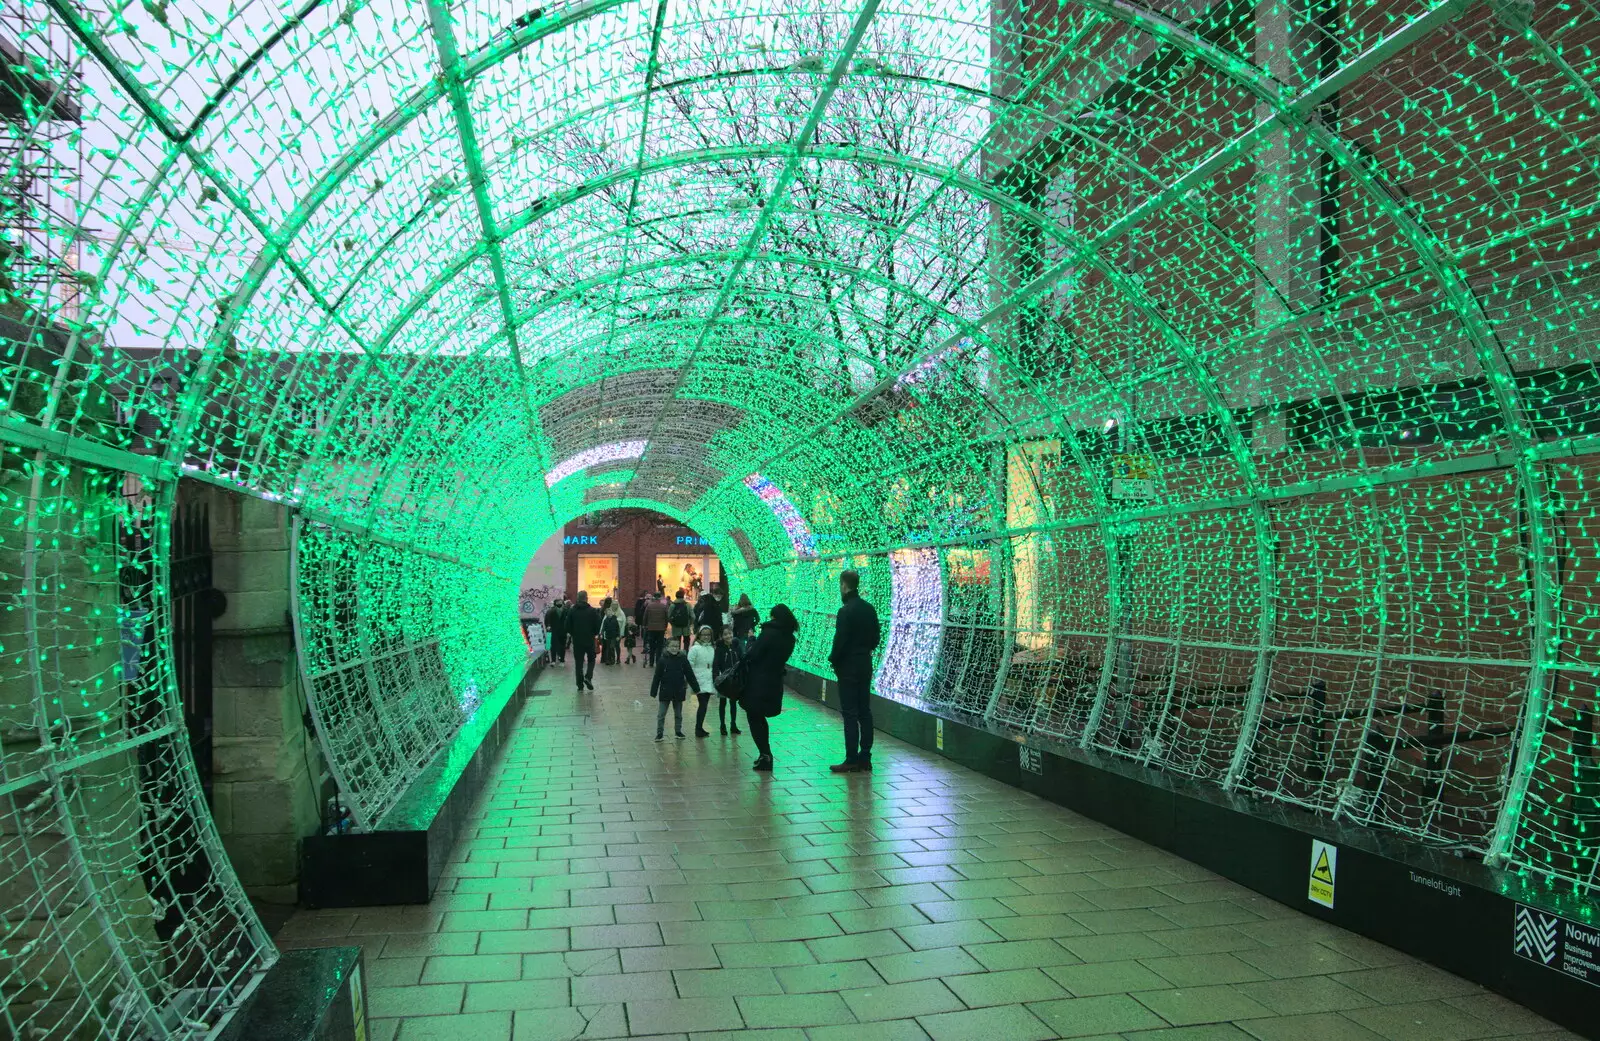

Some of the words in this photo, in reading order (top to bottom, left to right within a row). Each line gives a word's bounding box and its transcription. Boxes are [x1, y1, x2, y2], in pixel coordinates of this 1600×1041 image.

[562, 535, 598, 545] MARK
[1409, 870, 1462, 897] TunnelofLight
[1565, 923, 1600, 948] Norwi
[1564, 941, 1593, 959] Business
[1563, 962, 1588, 979] District
